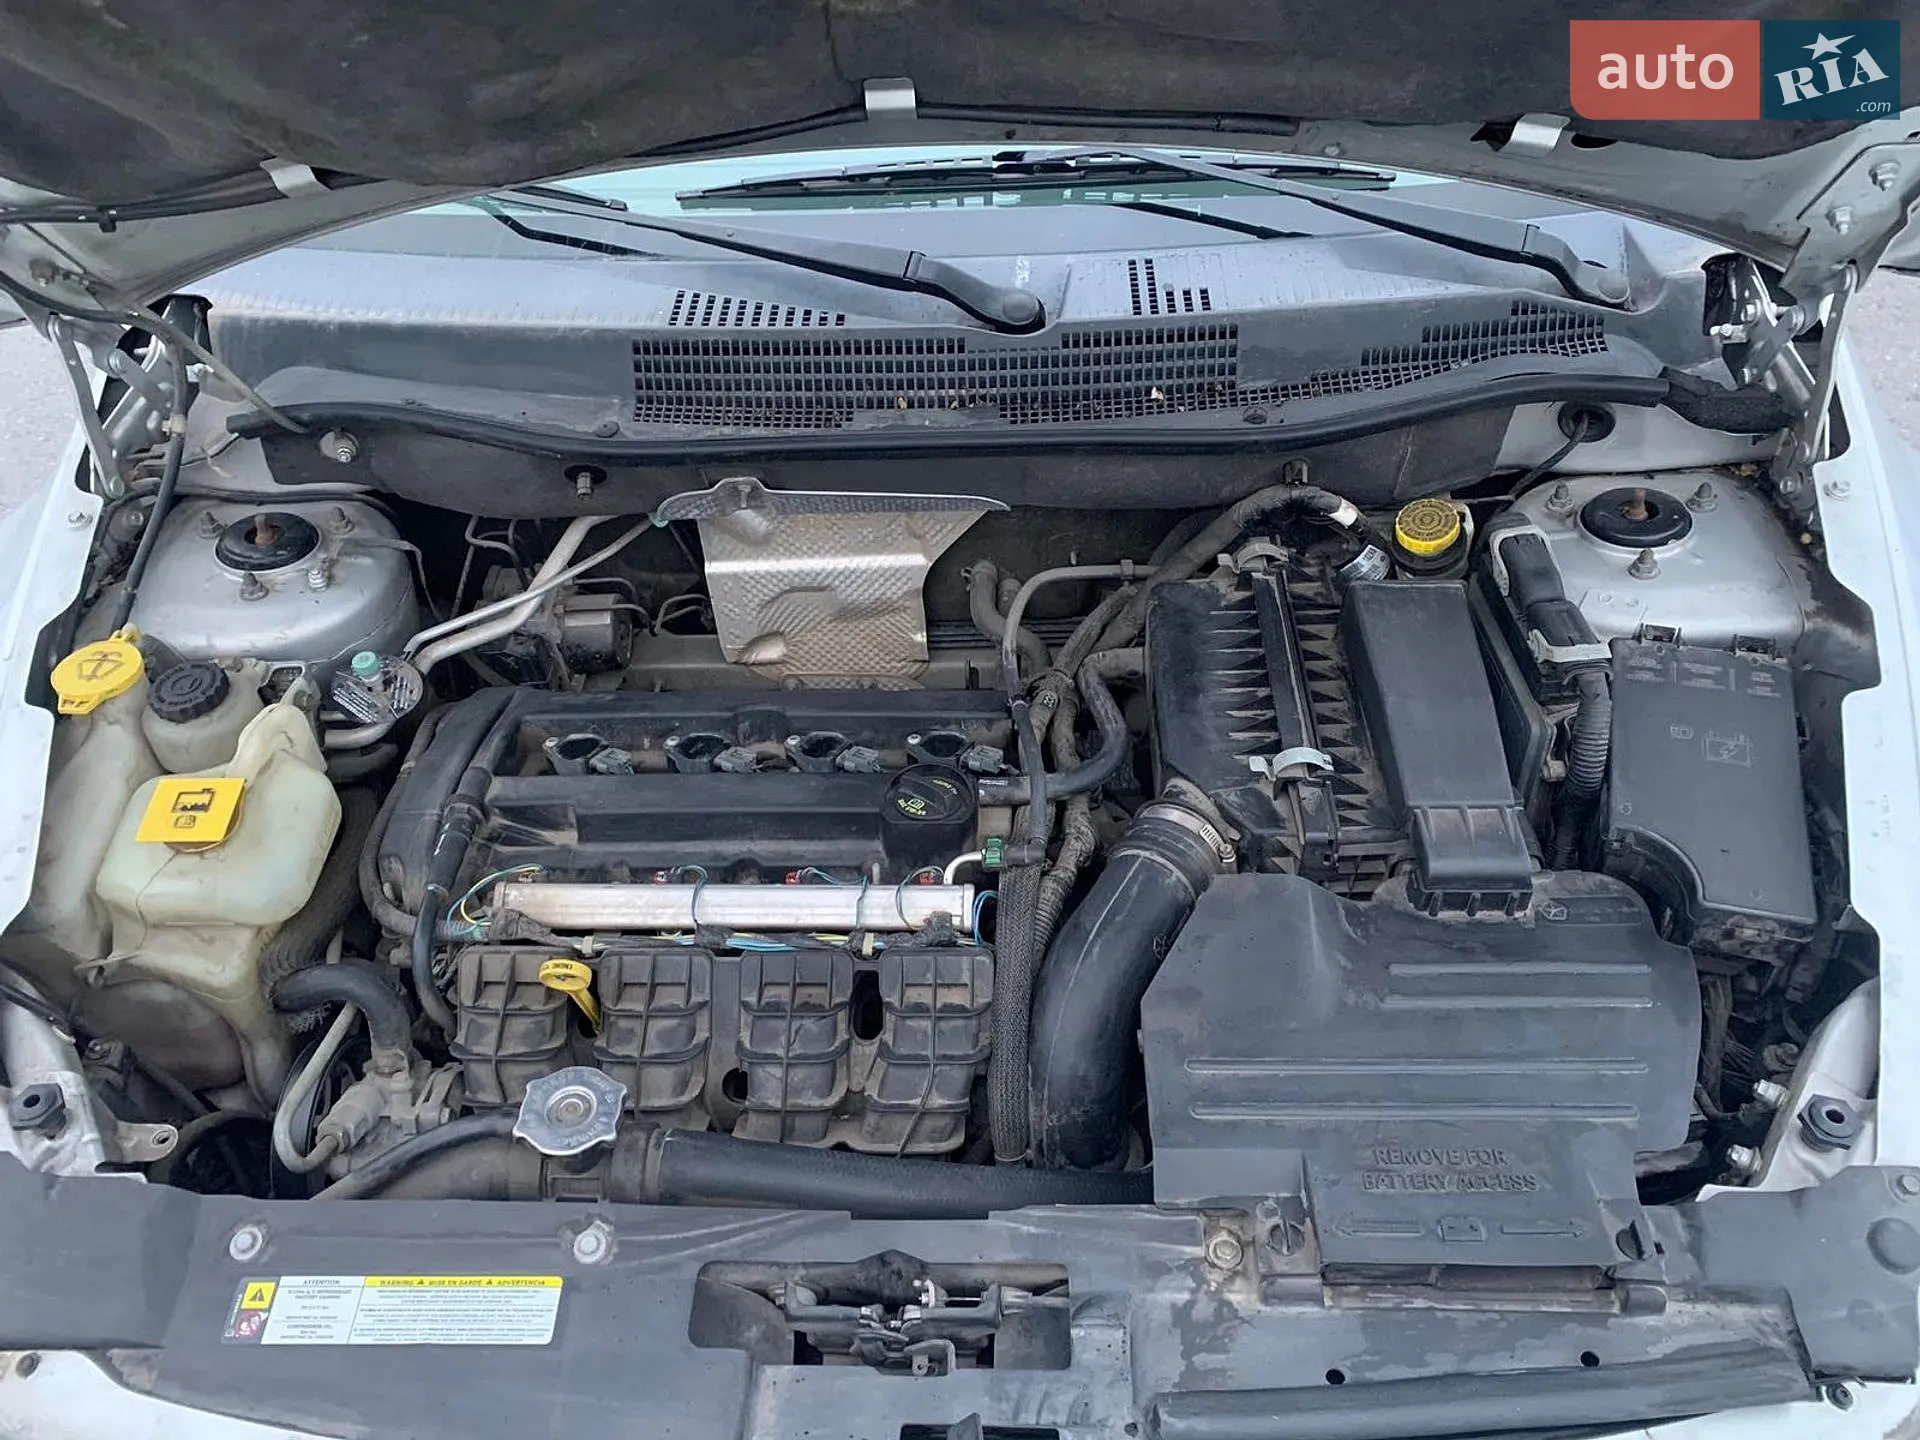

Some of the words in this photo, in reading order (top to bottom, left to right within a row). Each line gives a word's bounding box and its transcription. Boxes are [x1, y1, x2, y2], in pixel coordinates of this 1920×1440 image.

[1372, 1147, 1461, 1166] REMOVE
[1465, 1147, 1508, 1167] FOR
[1362, 1173, 1450, 1191] BATTERY
[1456, 1173, 1538, 1192] ACCESS
[379, 1279, 415, 1287] WARNING
